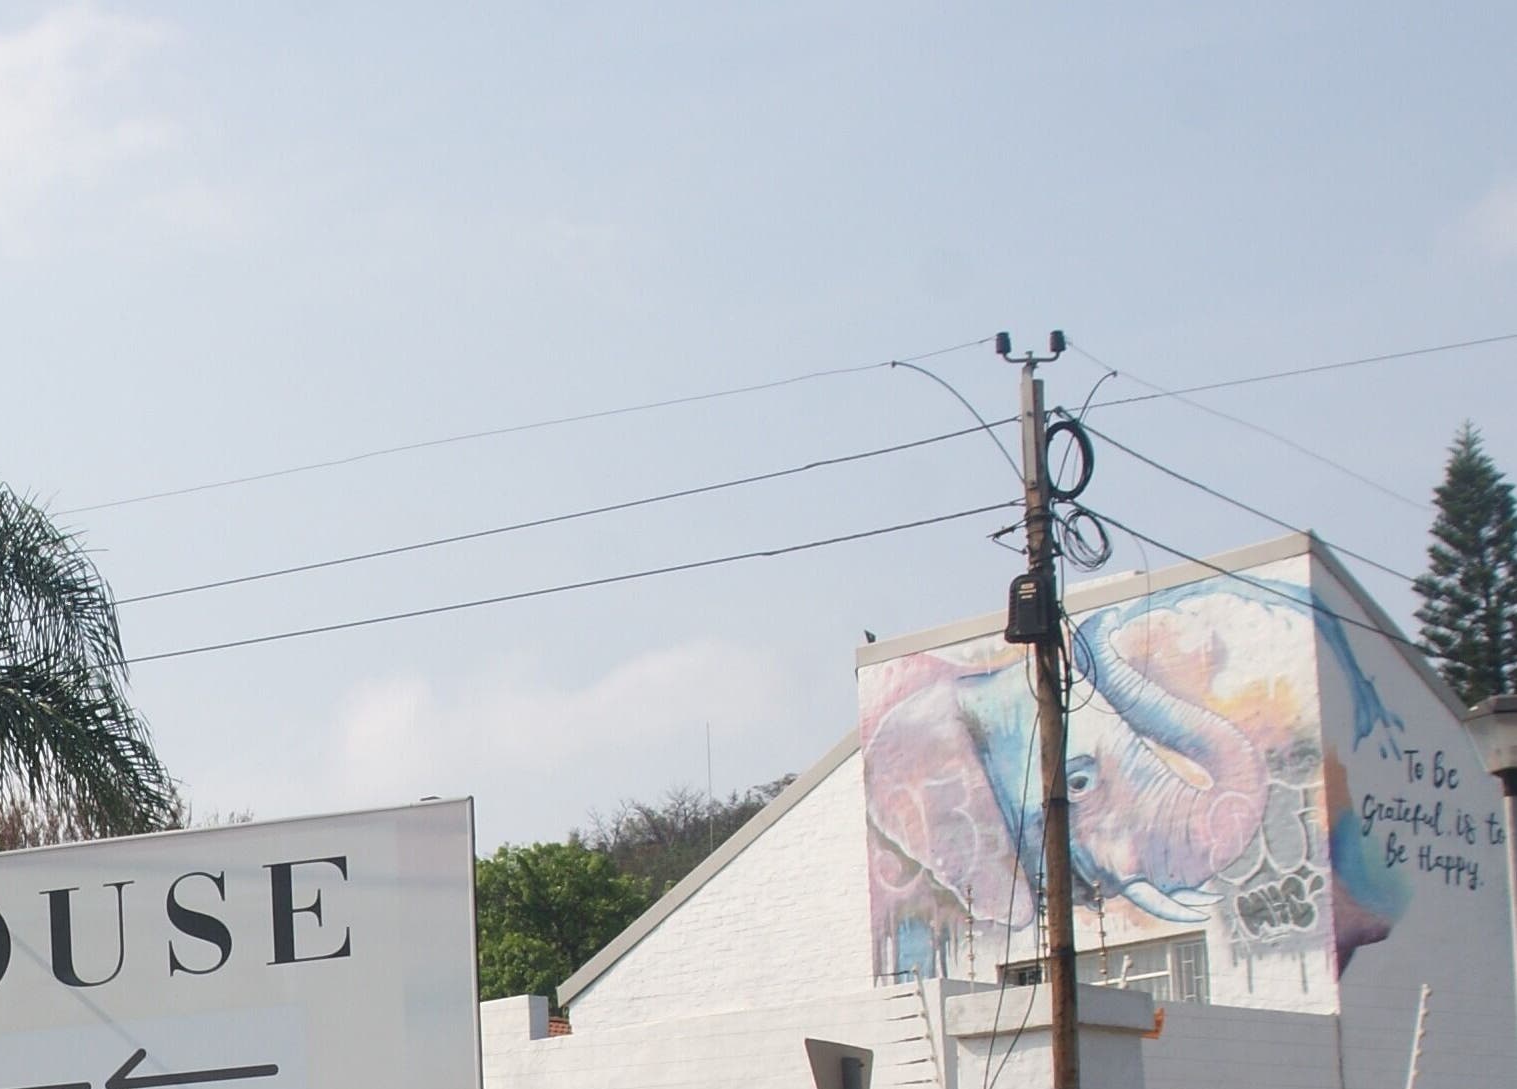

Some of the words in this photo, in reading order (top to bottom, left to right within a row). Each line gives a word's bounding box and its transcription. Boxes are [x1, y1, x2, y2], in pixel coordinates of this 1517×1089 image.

[1404, 750, 1424, 783] To
[1456, 809, 1476, 845] is
[1485, 812, 1506, 845] to
